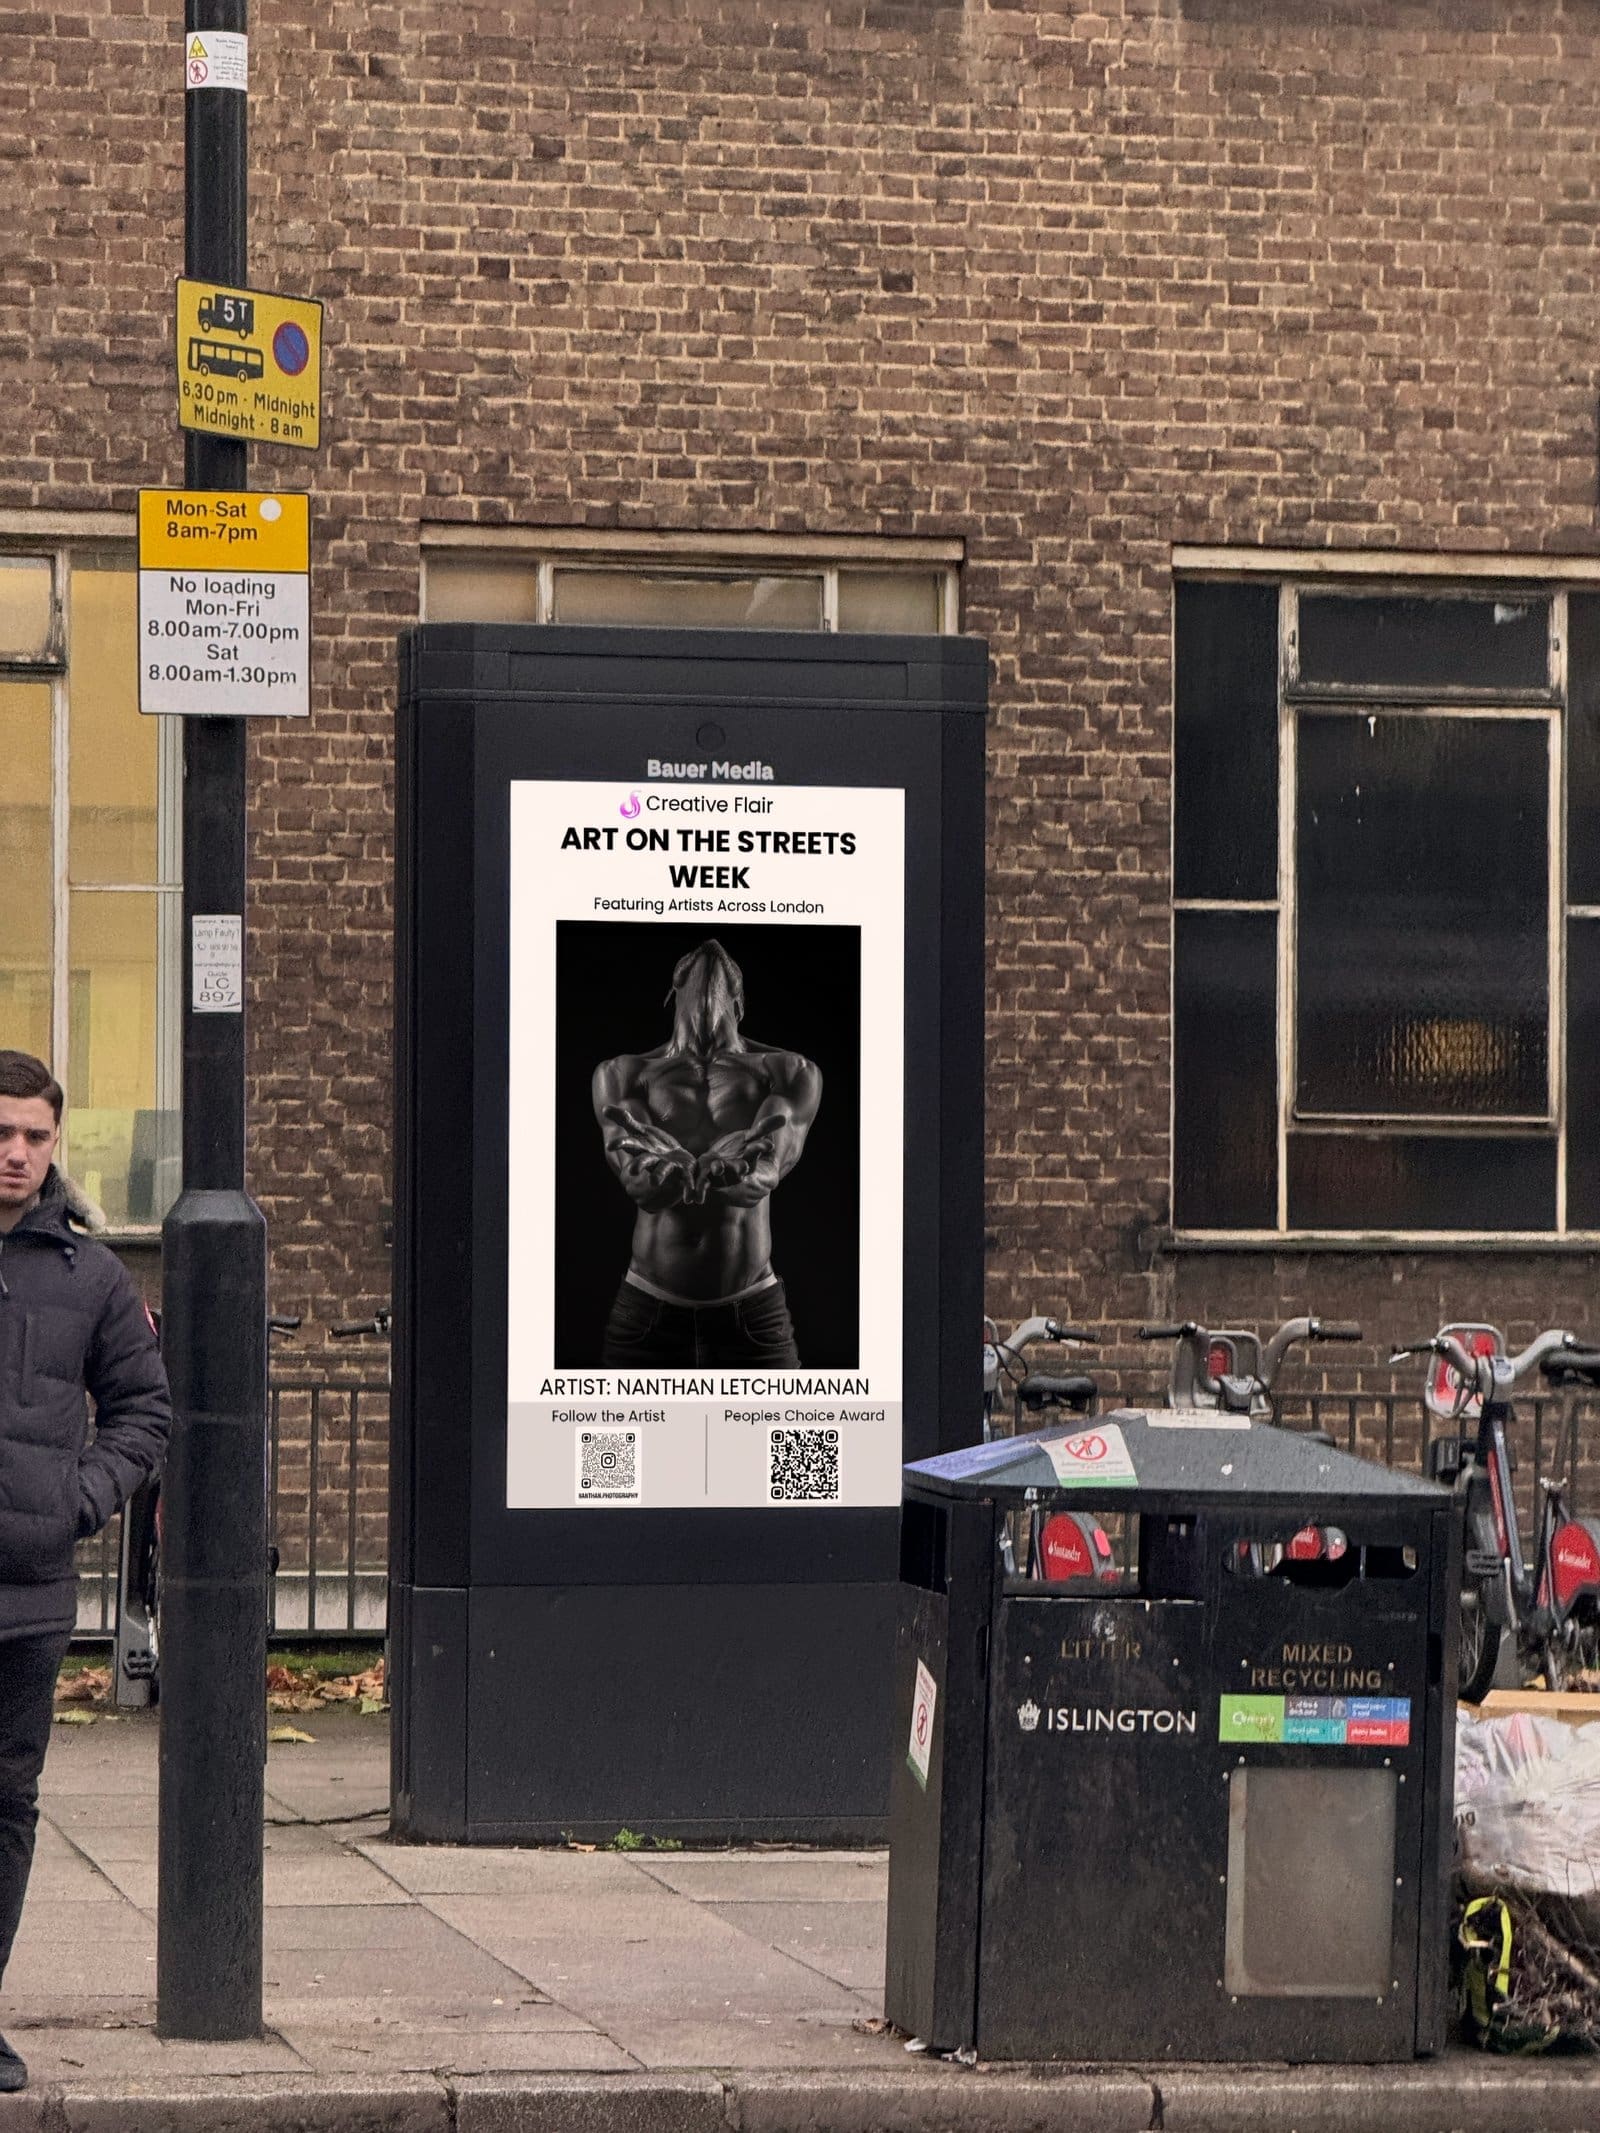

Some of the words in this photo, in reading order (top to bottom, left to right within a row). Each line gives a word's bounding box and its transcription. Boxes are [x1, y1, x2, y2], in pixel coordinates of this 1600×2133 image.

[254, 392, 315, 419] Midnight
[194, 405, 255, 431] Midnight
[167, 500, 246, 517] Mon-Sat
[167, 522, 257, 543] 8am-7pm
[171, 577, 196, 593] No
[205, 578, 275, 599] loading
[187, 599, 259, 616] Mon-Fri
[148, 620, 298, 643] 8.00am-7.00pm
[207, 644, 238, 660] Sat
[149, 664, 296, 687] 8.00am-1.30pm
[648, 760, 707, 778] Bauer
[712, 761, 774, 780] Media
[647, 796, 728, 812] Creative
[735, 797, 773, 813] Flair
[561, 827, 618, 850] ART
[626, 828, 669, 851] ON
[677, 829, 730, 852] THE
[738, 831, 856, 855] STREETS
[669, 865, 750, 888] WEEK
[595, 898, 664, 914] Featuring
[669, 898, 713, 911] Artists
[718, 900, 766, 912] Across
[771, 901, 823, 913] London
[205, 978, 229, 989] LC
[200, 991, 235, 1002] 897
[540, 1379, 610, 1395] ARTIST:
[618, 1379, 713, 1395] NANTHAN
[721, 1379, 868, 1395] LETCHUMANAN
[552, 1410, 596, 1422] Follow
[602, 1410, 624, 1422] the
[629, 1410, 665, 1422] Artist
[725, 1410, 780, 1425] Peoples
[785, 1409, 835, 1421] Choice
[840, 1410, 884, 1421] Award
[1281, 1643, 1354, 1664] MIXED
[1250, 1667, 1384, 1690] RECYCLING
[1048, 1709, 1195, 1733] ISLINGTON
